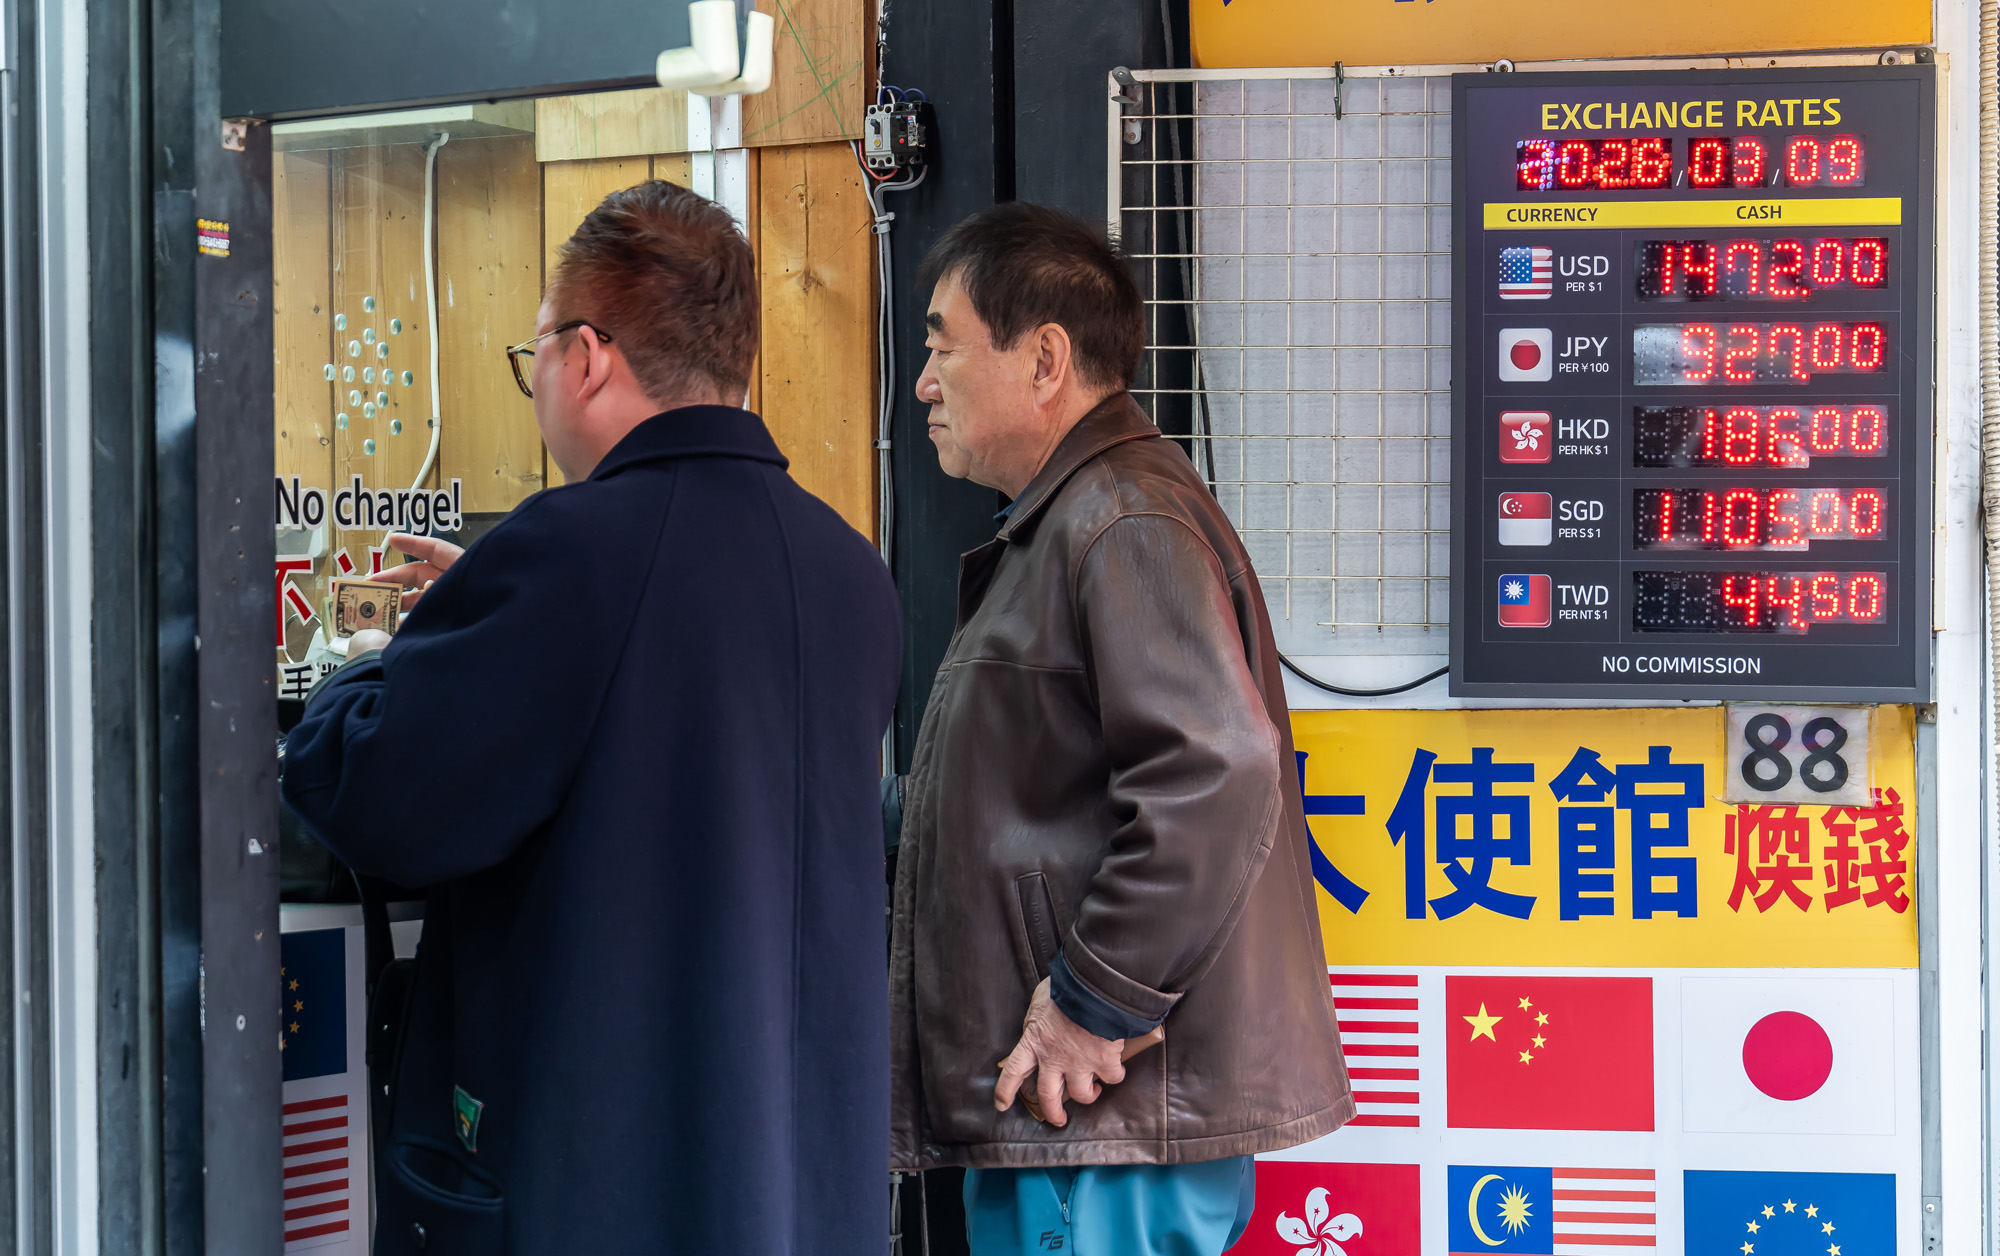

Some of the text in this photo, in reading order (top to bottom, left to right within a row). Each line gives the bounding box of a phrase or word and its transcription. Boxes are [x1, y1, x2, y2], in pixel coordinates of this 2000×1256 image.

[1541, 98, 1842, 131] EXCHANGE RATES
[1506, 207, 1599, 223] CURRENCY
[1736, 205, 1782, 220] CASH
[1559, 255, 1609, 277] USD
[1566, 282, 1586, 292] PER
[1559, 336, 1609, 358] JPY
[1558, 363, 1580, 373] PER
[1558, 418, 1610, 440] HKD
[1558, 444, 1578, 455] PER
[276, 477, 461, 536] No charge!
[1559, 500, 1604, 521] SGD
[1558, 528, 1578, 538] PER
[1557, 584, 1609, 606] TWD
[1558, 609, 1578, 620] PER
[1602, 656, 1762, 674] NO COMMISSION
[281, 662, 340, 699] 手
[1741, 712, 1850, 794] 88
[1040, 1229, 1065, 1251] FG
